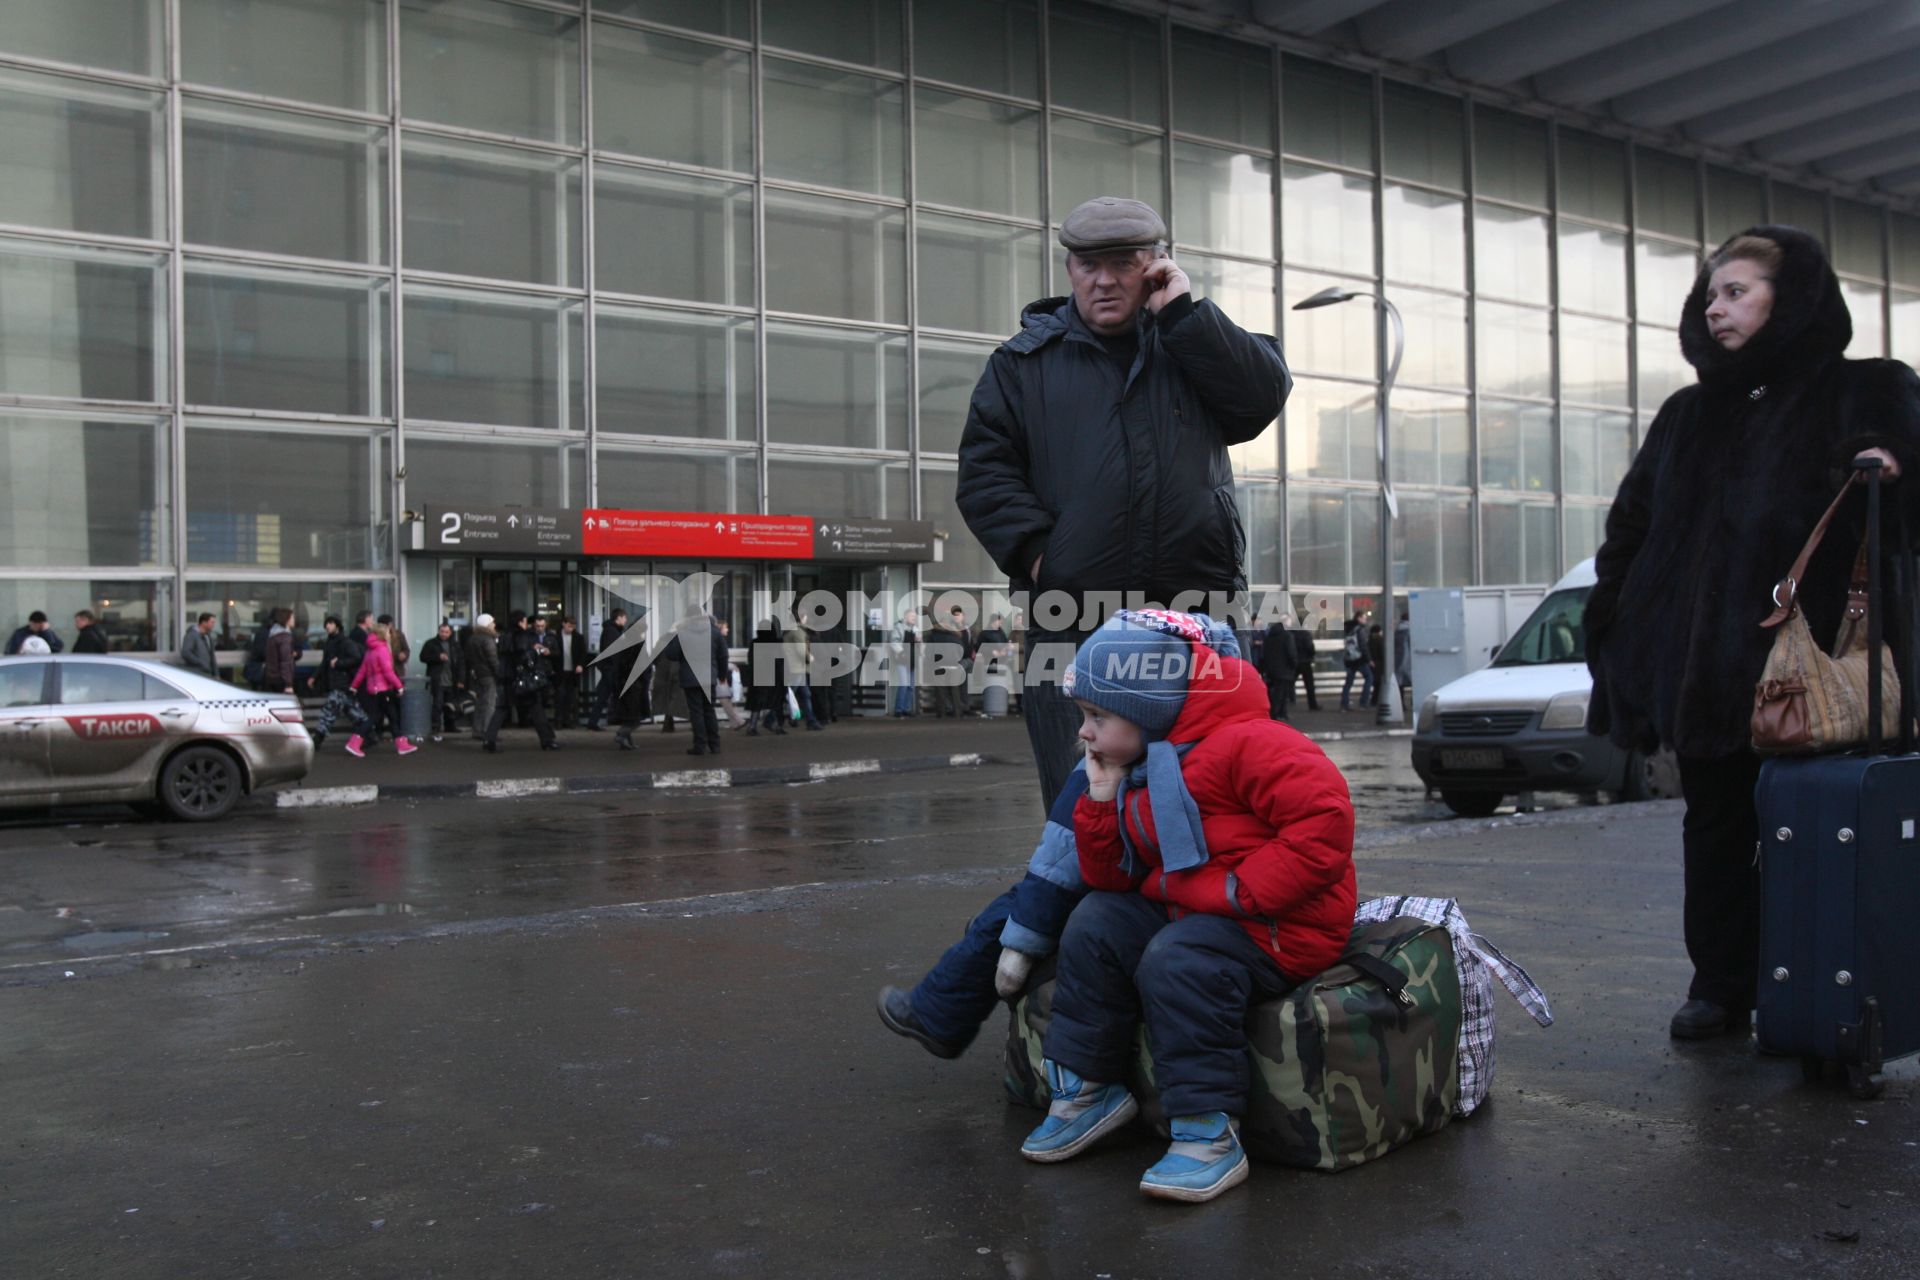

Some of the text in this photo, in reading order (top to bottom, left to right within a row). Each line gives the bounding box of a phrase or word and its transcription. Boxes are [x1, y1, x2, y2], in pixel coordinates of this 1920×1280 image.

[464, 512, 497, 523] Подъезд
[538, 516, 557, 525] Вход
[441, 512, 461, 544] 2
[613, 518, 638, 527] Поезда
[640, 519, 671, 528] дальнего
[464, 529, 499, 539] Entrance
[538, 532, 571, 541] Entrance
[80, 718, 151, 737] ТАКСИ
